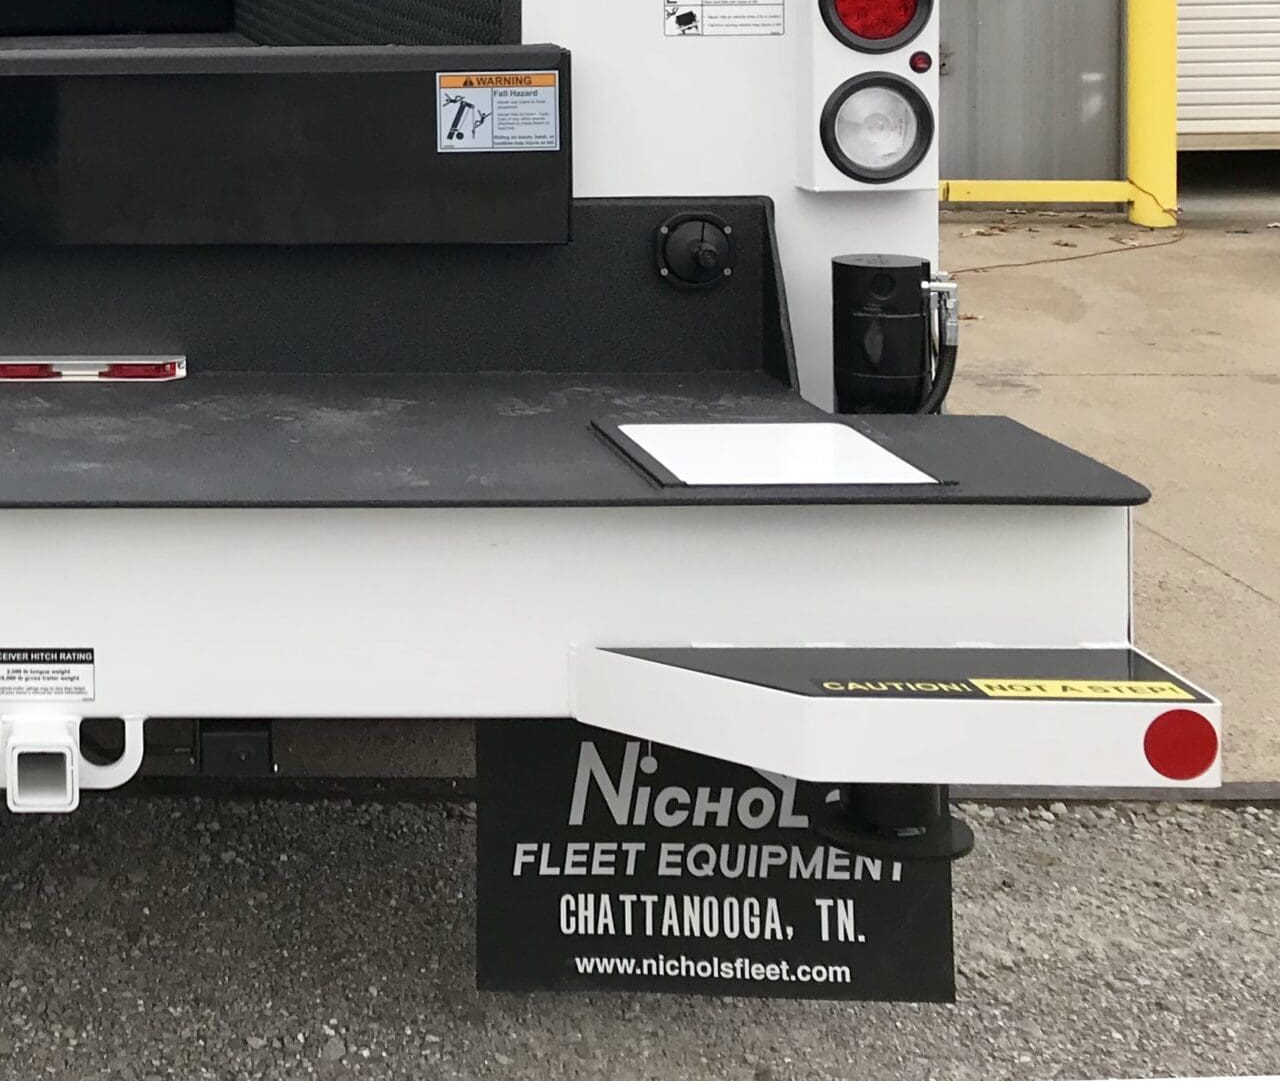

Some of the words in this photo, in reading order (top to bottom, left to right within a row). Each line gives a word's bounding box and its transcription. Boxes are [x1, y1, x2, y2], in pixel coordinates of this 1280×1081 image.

[476, 76, 532, 86] WARNING
[30, 652, 57, 660] HITCH
[60, 652, 92, 660] RATING
[823, 681, 972, 692] CAUTION!
[984, 683, 1048, 693] NOT
[1061, 685, 1078, 693] A
[1088, 685, 1184, 694] STEP!
[513, 842, 645, 876] FLEET
[559, 893, 794, 941] CHATTANOOGA,
[815, 899, 865, 943] TN.
[575, 954, 851, 983] www.nicholsfleet.com
